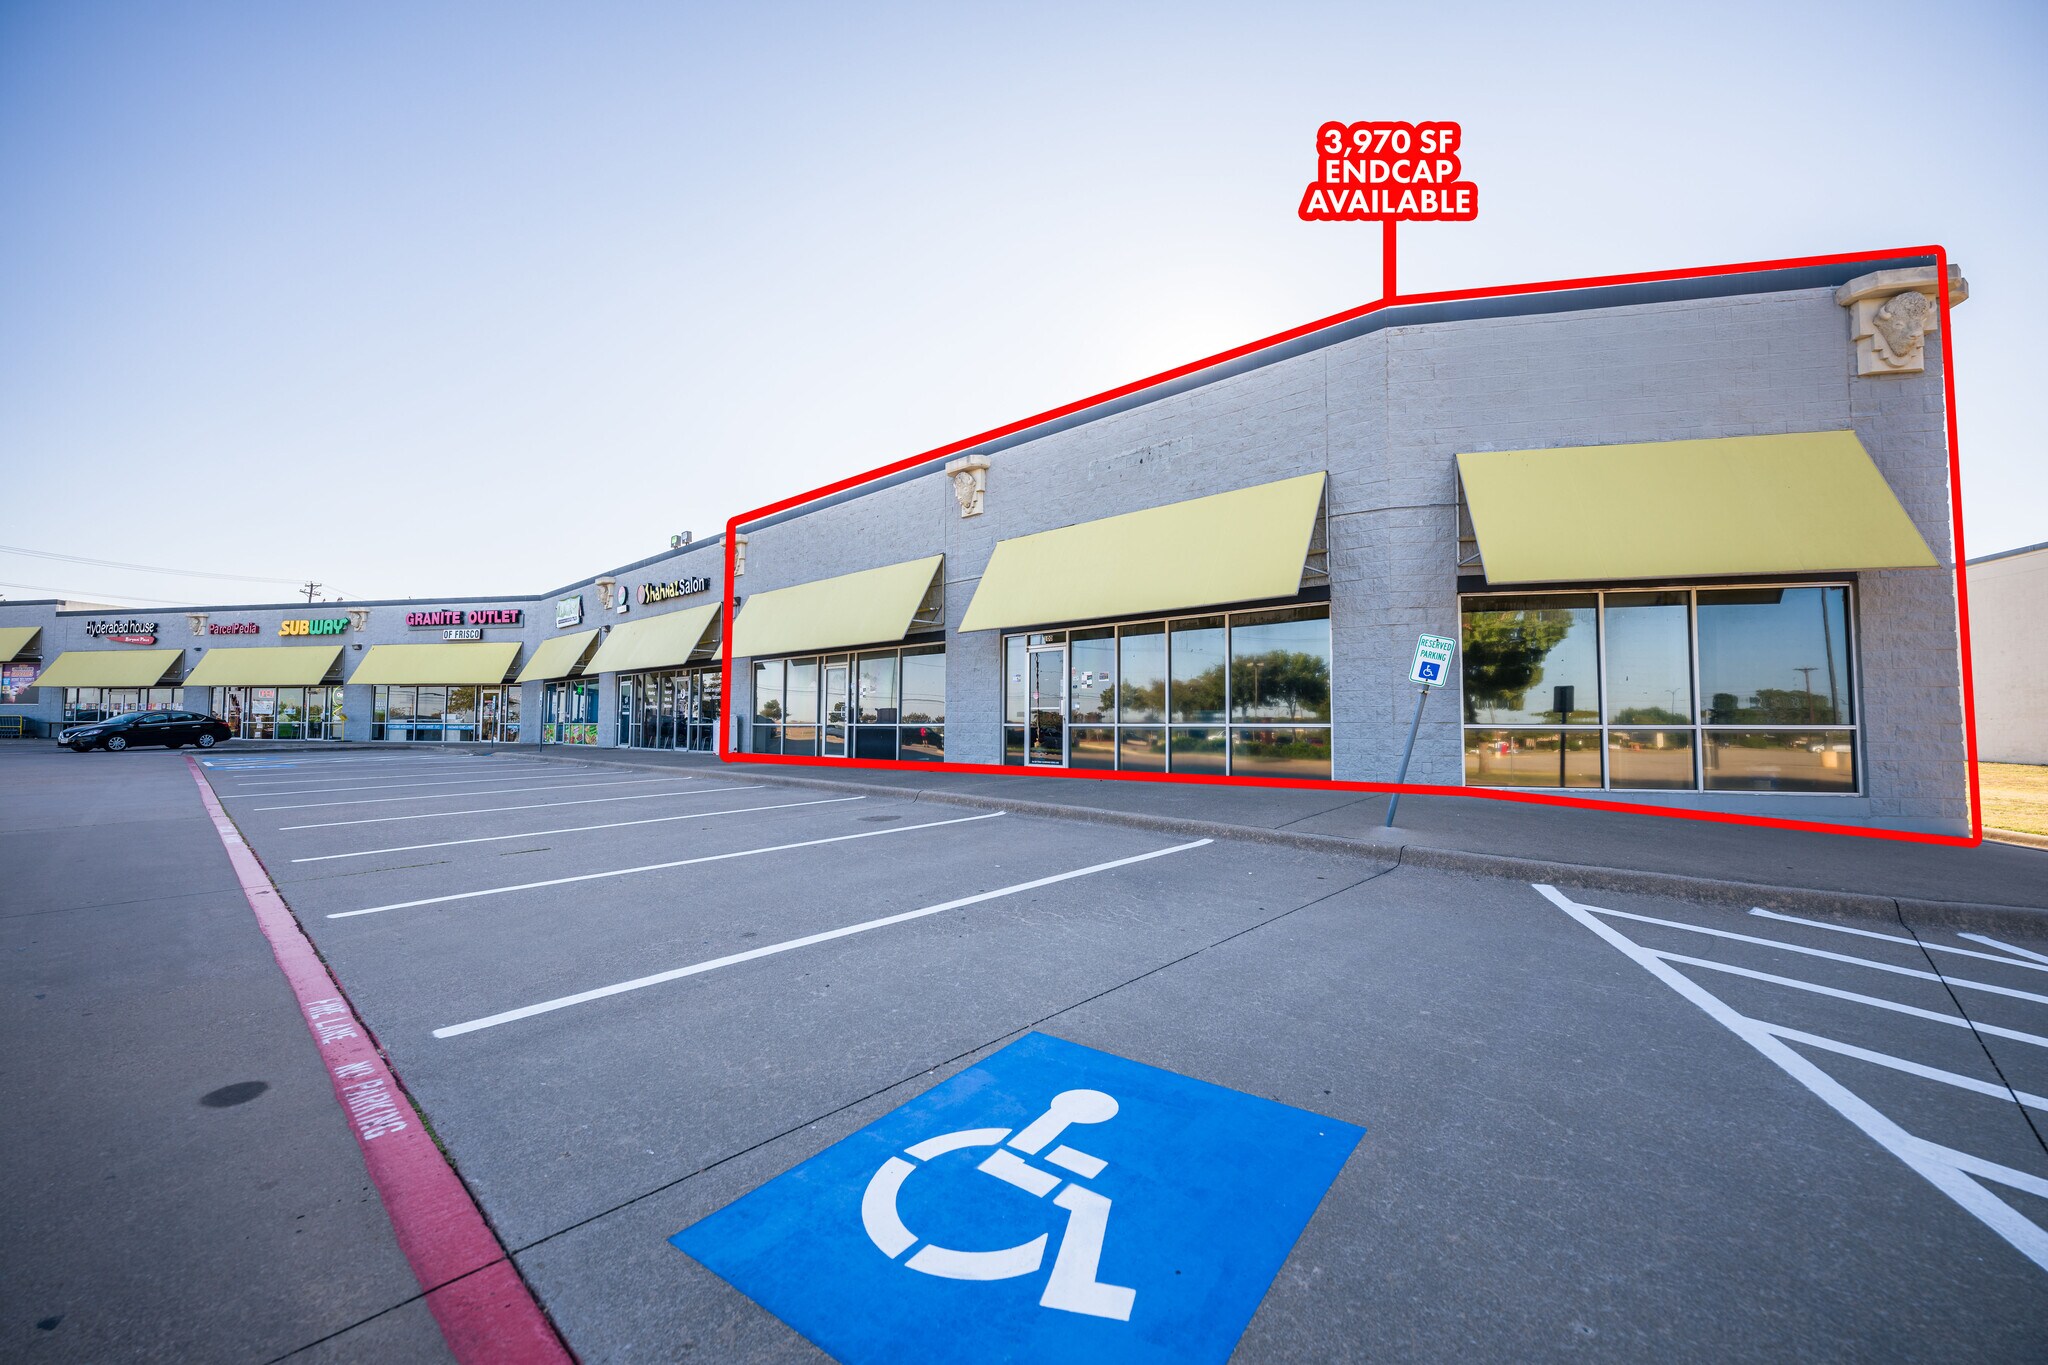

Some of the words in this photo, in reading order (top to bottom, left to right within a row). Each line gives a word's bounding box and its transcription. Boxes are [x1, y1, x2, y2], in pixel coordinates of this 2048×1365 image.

[679, 576, 705, 596] Salon
[405, 611, 461, 625] GRANITE
[468, 609, 519, 624] OUTLET
[278, 617, 348, 637] SUBWAY
[443, 630, 453, 639] OF
[454, 629, 480, 639] FRISCO
[1421, 638, 1452, 651] RESERVED
[1420, 650, 1447, 661] PARKING
[306, 997, 346, 1020] FIRE
[314, 1016, 358, 1045] LANE
[334, 1060, 375, 1079] NO
[342, 1078, 408, 1141] PARKING
